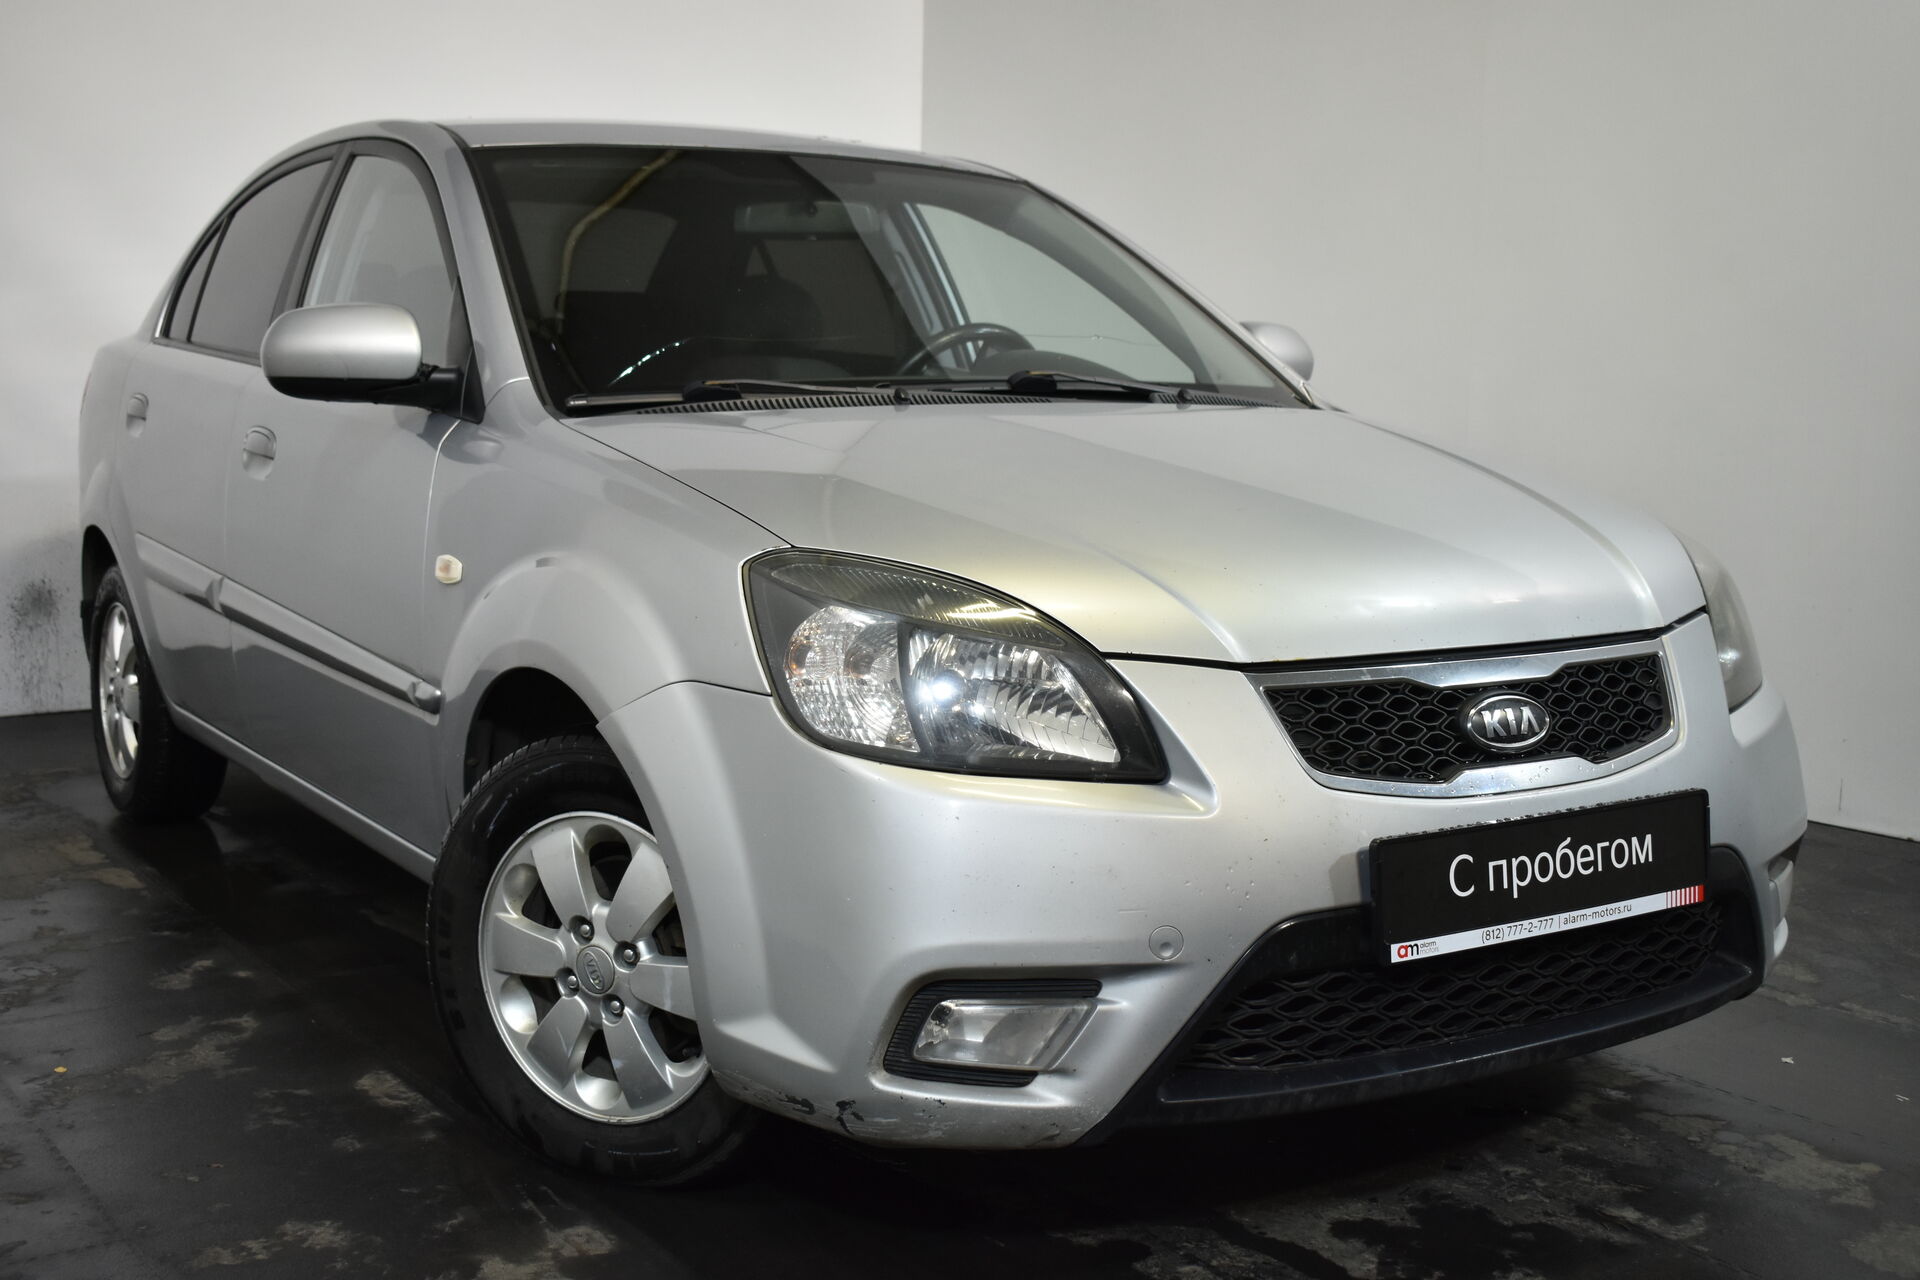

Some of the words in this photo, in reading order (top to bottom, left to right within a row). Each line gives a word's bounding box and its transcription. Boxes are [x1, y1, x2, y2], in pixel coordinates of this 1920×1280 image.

[1481, 706, 1540, 738] KIA
[1449, 854, 1475, 897] С
[1488, 833, 1653, 899] пробегом
[1481, 927, 1505, 944] (812)
[1507, 918, 1554, 937] 777-2-777
[1563, 904, 1633, 925] alarm-motors.ru
[1420, 940, 1437, 949] alarm
